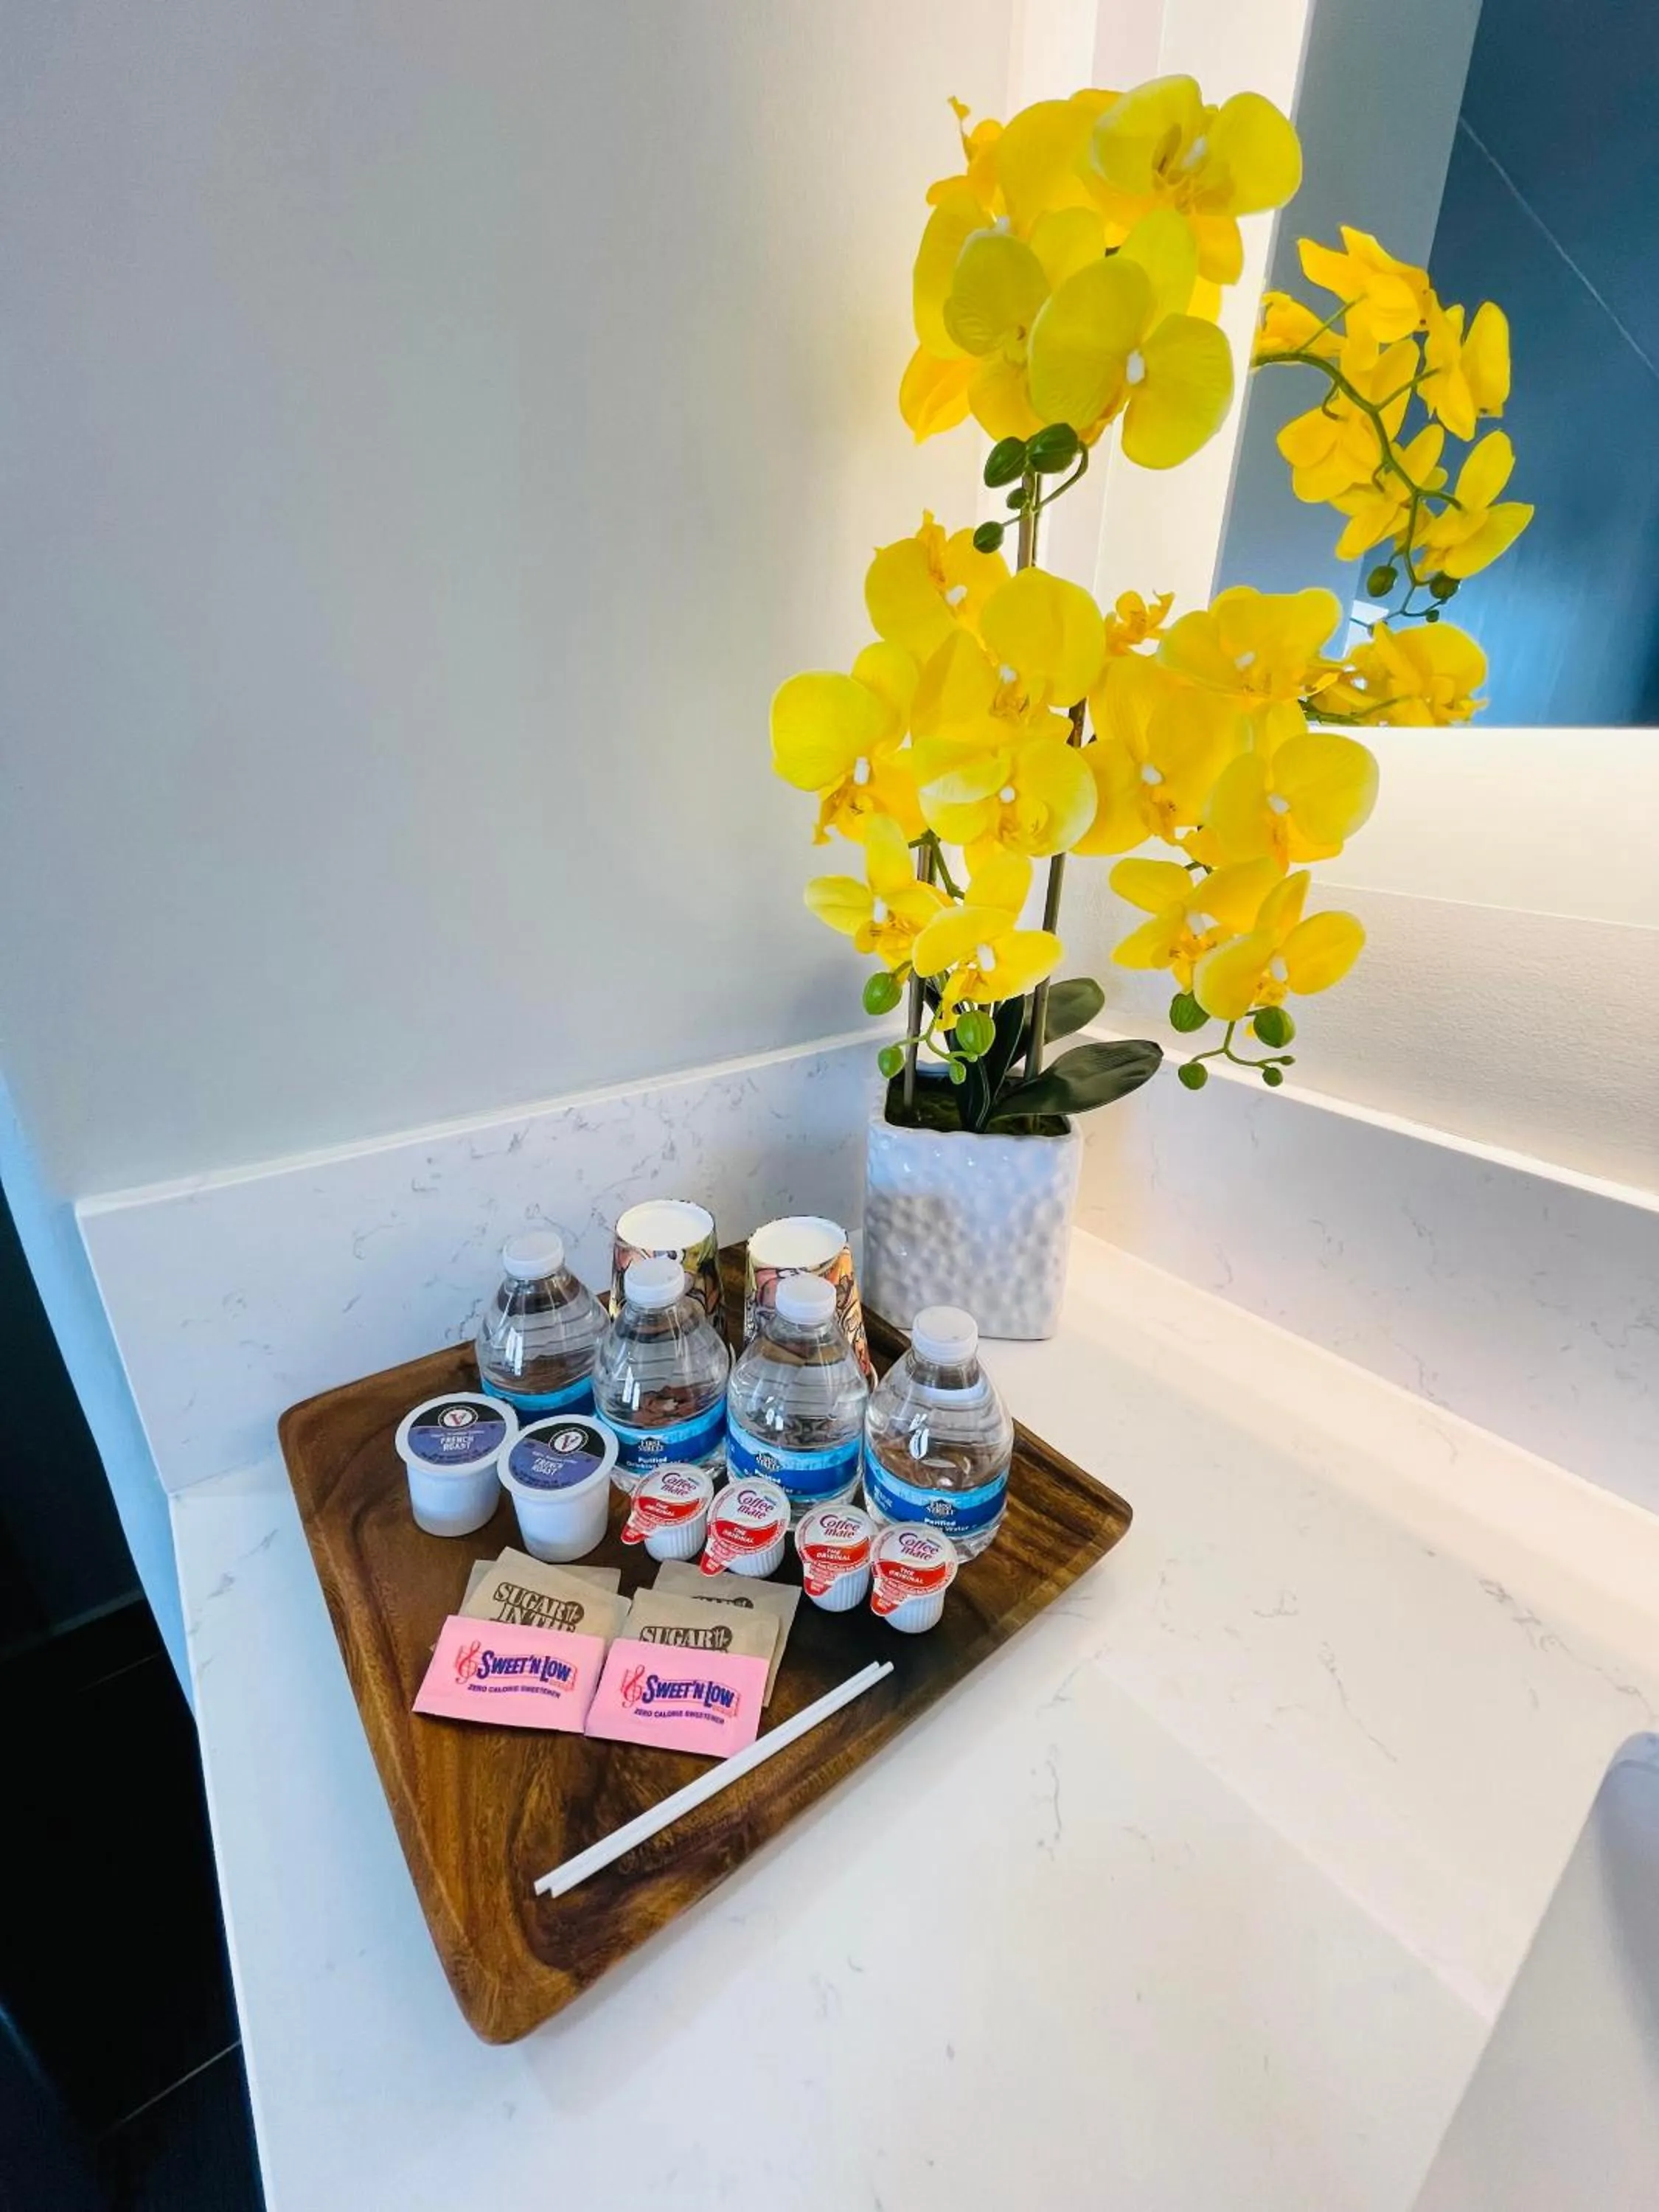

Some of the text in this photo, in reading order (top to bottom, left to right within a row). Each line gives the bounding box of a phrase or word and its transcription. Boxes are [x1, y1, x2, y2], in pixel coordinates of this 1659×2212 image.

[440, 1436, 474, 1445] FRENCH
[443, 1443, 471, 1452] ROAST
[531, 1464, 558, 1475] ROAST
[661, 1472, 697, 1490] Coffee
[661, 1484, 689, 1497] mate
[738, 1489, 774, 1512] Coffee
[737, 1505, 767, 1520] mate
[819, 1514, 860, 1531] Coffee
[924, 1517, 956, 1526] Purified
[722, 1529, 754, 1544] ORIGINAL
[824, 1528, 855, 1539] mate
[899, 1532, 939, 1555] Coffee
[816, 1552, 851, 1561] ORIGINAL
[900, 1545, 933, 1561] mate
[888, 1570, 924, 1585] ORIGINAL
[495, 1582, 567, 1623] SUGAR
[641, 1627, 714, 1649] SUGAR
[467, 1683, 561, 1699] ZERO CALORIE SWEETENER
[634, 1708, 725, 1725] ZERO CALORIE SWEETENER
